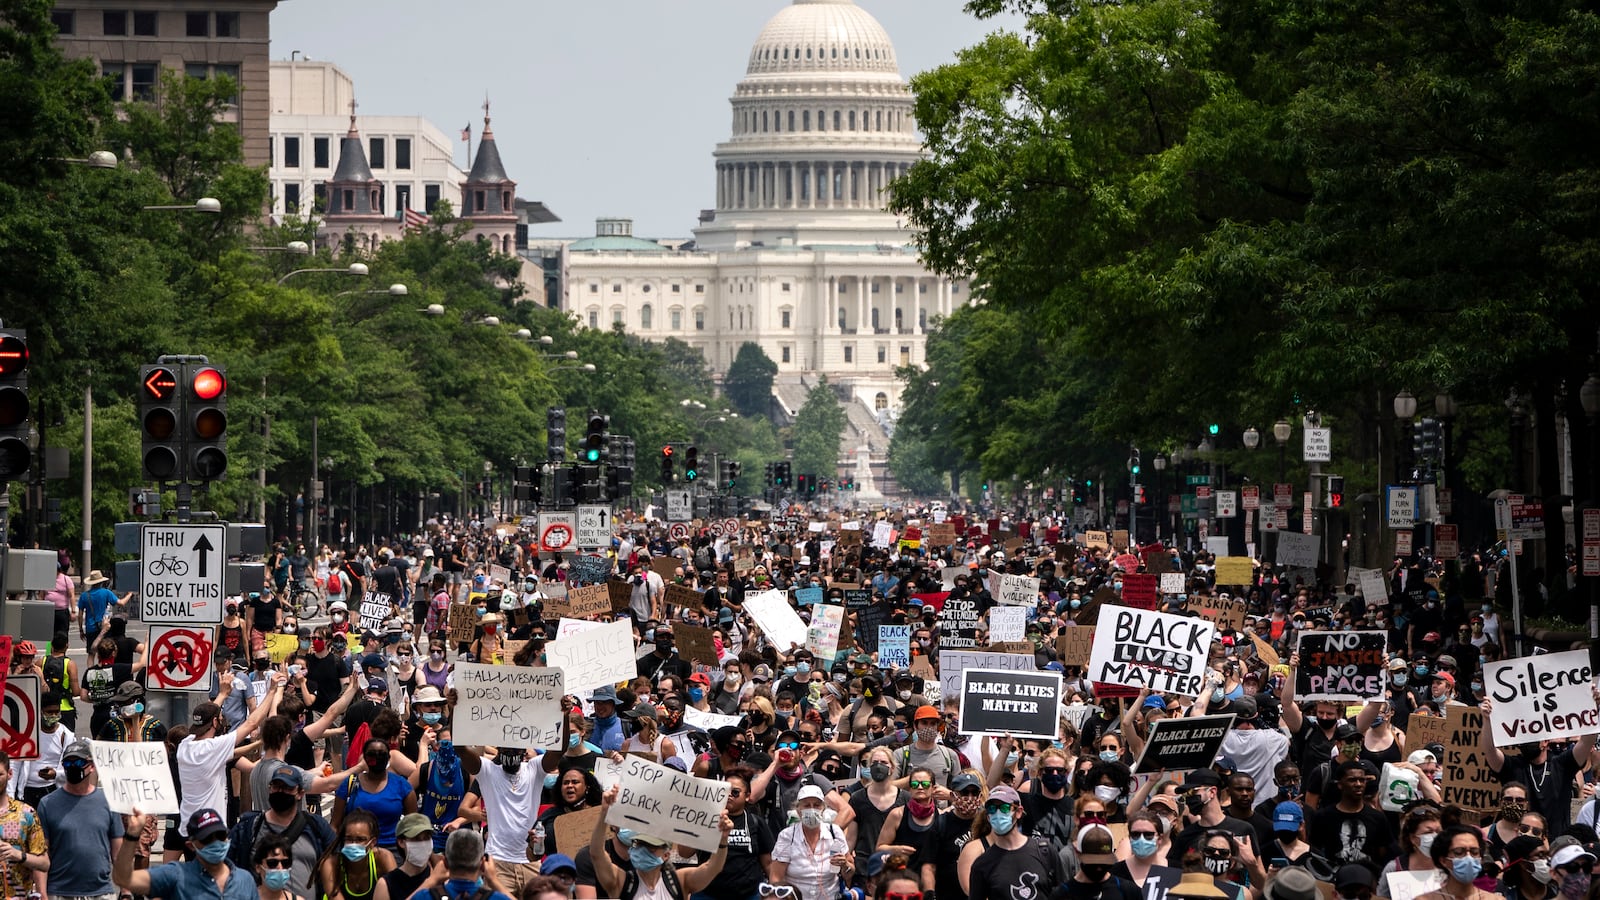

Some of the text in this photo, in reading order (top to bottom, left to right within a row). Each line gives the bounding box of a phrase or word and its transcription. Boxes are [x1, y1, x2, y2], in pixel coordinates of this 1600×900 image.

[1397, 491, 1406, 499] NO
[148, 531, 185, 547] THRU
[580, 529, 595, 537] OBEY
[146, 582, 219, 599] OBEY THIS
[1004, 578, 1032, 589] SILENCE
[364, 591, 392, 606] BLACK
[570, 585, 607, 600] JUSTICE
[581, 594, 597, 603] FOR
[1002, 591, 1035, 604] VIOLENCE
[145, 601, 195, 617] SIGNAL
[361, 603, 389, 618] LIVES
[452, 606, 475, 617] BLACK
[944, 599, 976, 611] STOP
[1205, 598, 1234, 610] SKIN
[942, 609, 980, 620] PRETENDING
[360, 616, 382, 631] MATTE
[451, 619, 473, 629] LIVES
[941, 620, 978, 630] YOUR RACISM
[880, 626, 908, 638] BLACK
[950, 630, 960, 638] IS
[1071, 626, 1095, 642] BLA
[1114, 610, 1208, 655] BLACK
[554, 630, 629, 667] SILENCE
[940, 636, 976, 648] PATRIOTISM
[1069, 643, 1089, 654] LIV
[1324, 632, 1361, 653] NO
[883, 649, 906, 658] LIVES
[1067, 653, 1091, 664] MAT
[1120, 644, 1190, 671] LIVES
[1310, 649, 1383, 667] JUSTICE
[879, 657, 909, 668] MATTER
[566, 659, 635, 691] IOLENCE
[1099, 661, 1202, 696] MATTER
[1326, 664, 1358, 679] NO
[967, 681, 1055, 698] BLACK LIVES
[1310, 674, 1379, 694] PEACE
[1491, 662, 1593, 704] Silence
[466, 686, 501, 701] DOES
[509, 687, 554, 701] INCLUDE
[982, 698, 1039, 714] MATTER
[1533, 692, 1558, 713] is
[471, 704, 523, 722] BLACK
[1418, 718, 1438, 730] WE
[502, 721, 562, 747] PEOPLE!
[1154, 727, 1225, 742] BLACK LIVES
[1159, 742, 1206, 755] MATTER
[95, 746, 164, 770] BLACK LIVES
[1448, 751, 1479, 767] IS A
[1446, 765, 1465, 782] TO
[627, 760, 727, 803] STOP KILLING
[111, 777, 165, 803] MATTER
[1443, 786, 1501, 809] EVERYW
[620, 788, 721, 830] BLACK PEOPLE
[1204, 856, 1229, 874] VOTE
